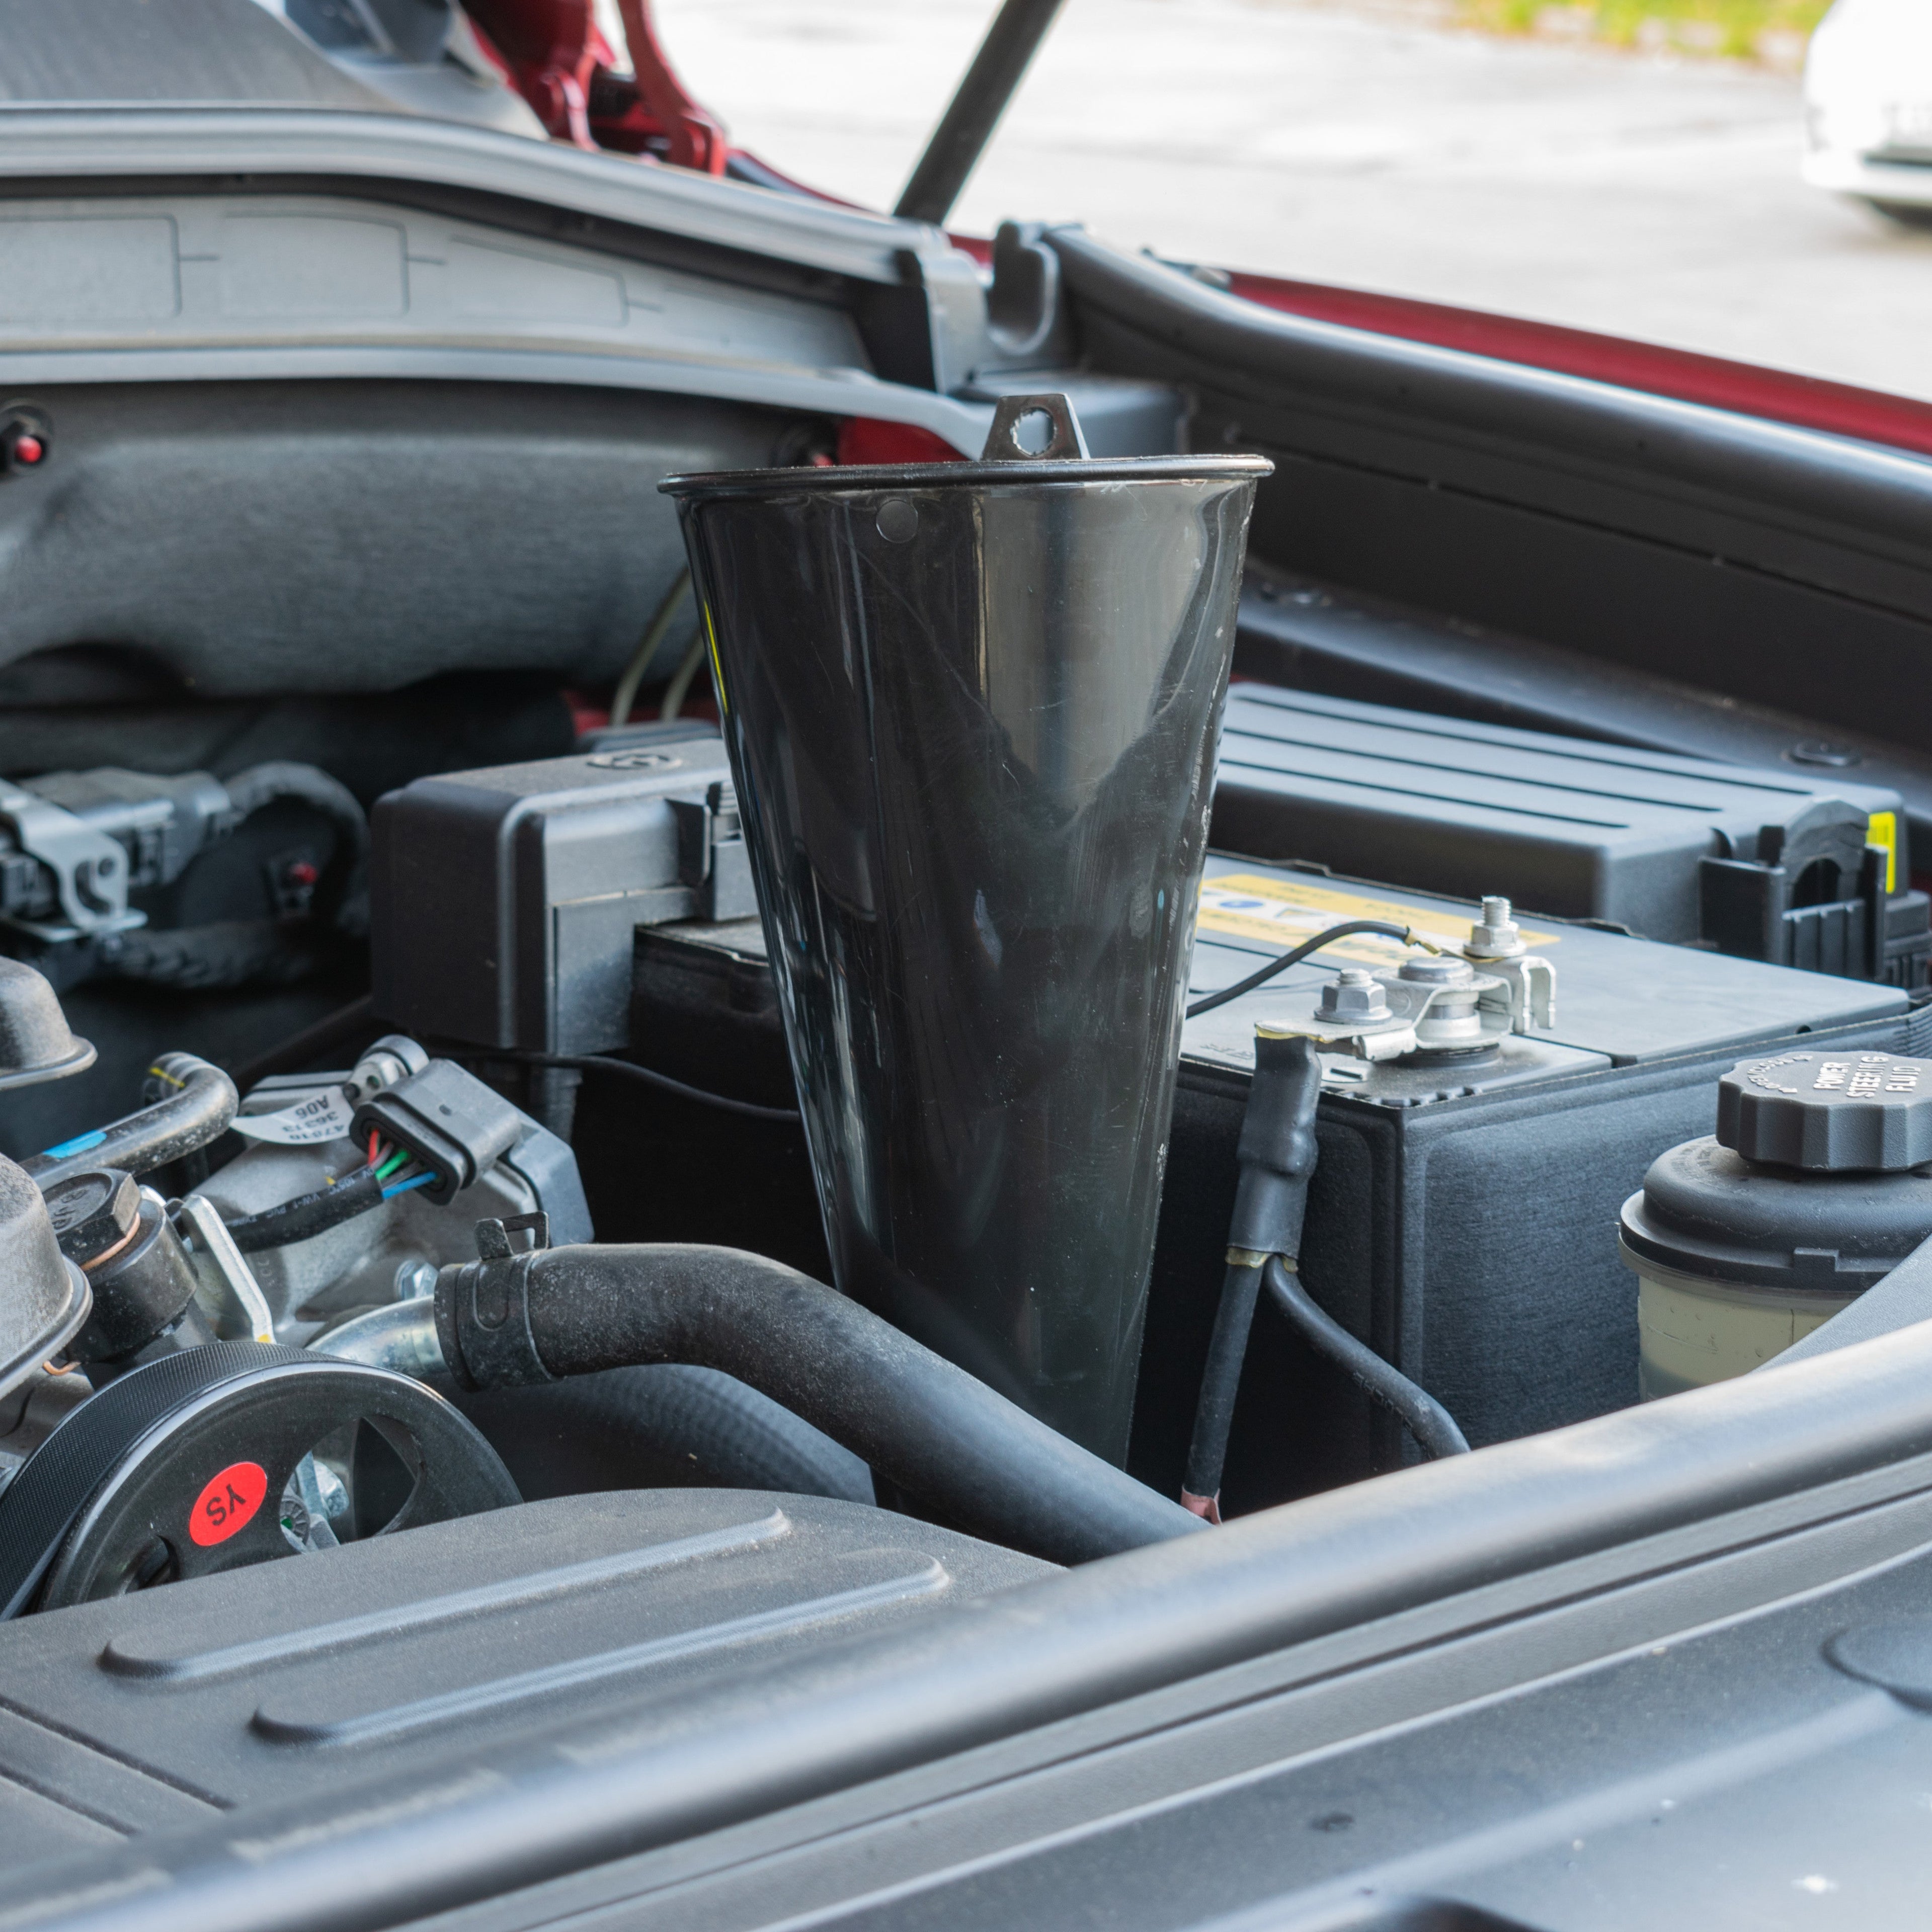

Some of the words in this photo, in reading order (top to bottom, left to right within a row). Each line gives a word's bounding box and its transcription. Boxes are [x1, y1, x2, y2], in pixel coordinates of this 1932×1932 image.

[1813, 1062, 1852, 1090] POWER
[1846, 1056, 1889, 1098] STEERING
[1885, 1065, 1921, 1092] FLUID
[295, 1095, 329, 1119] A06
